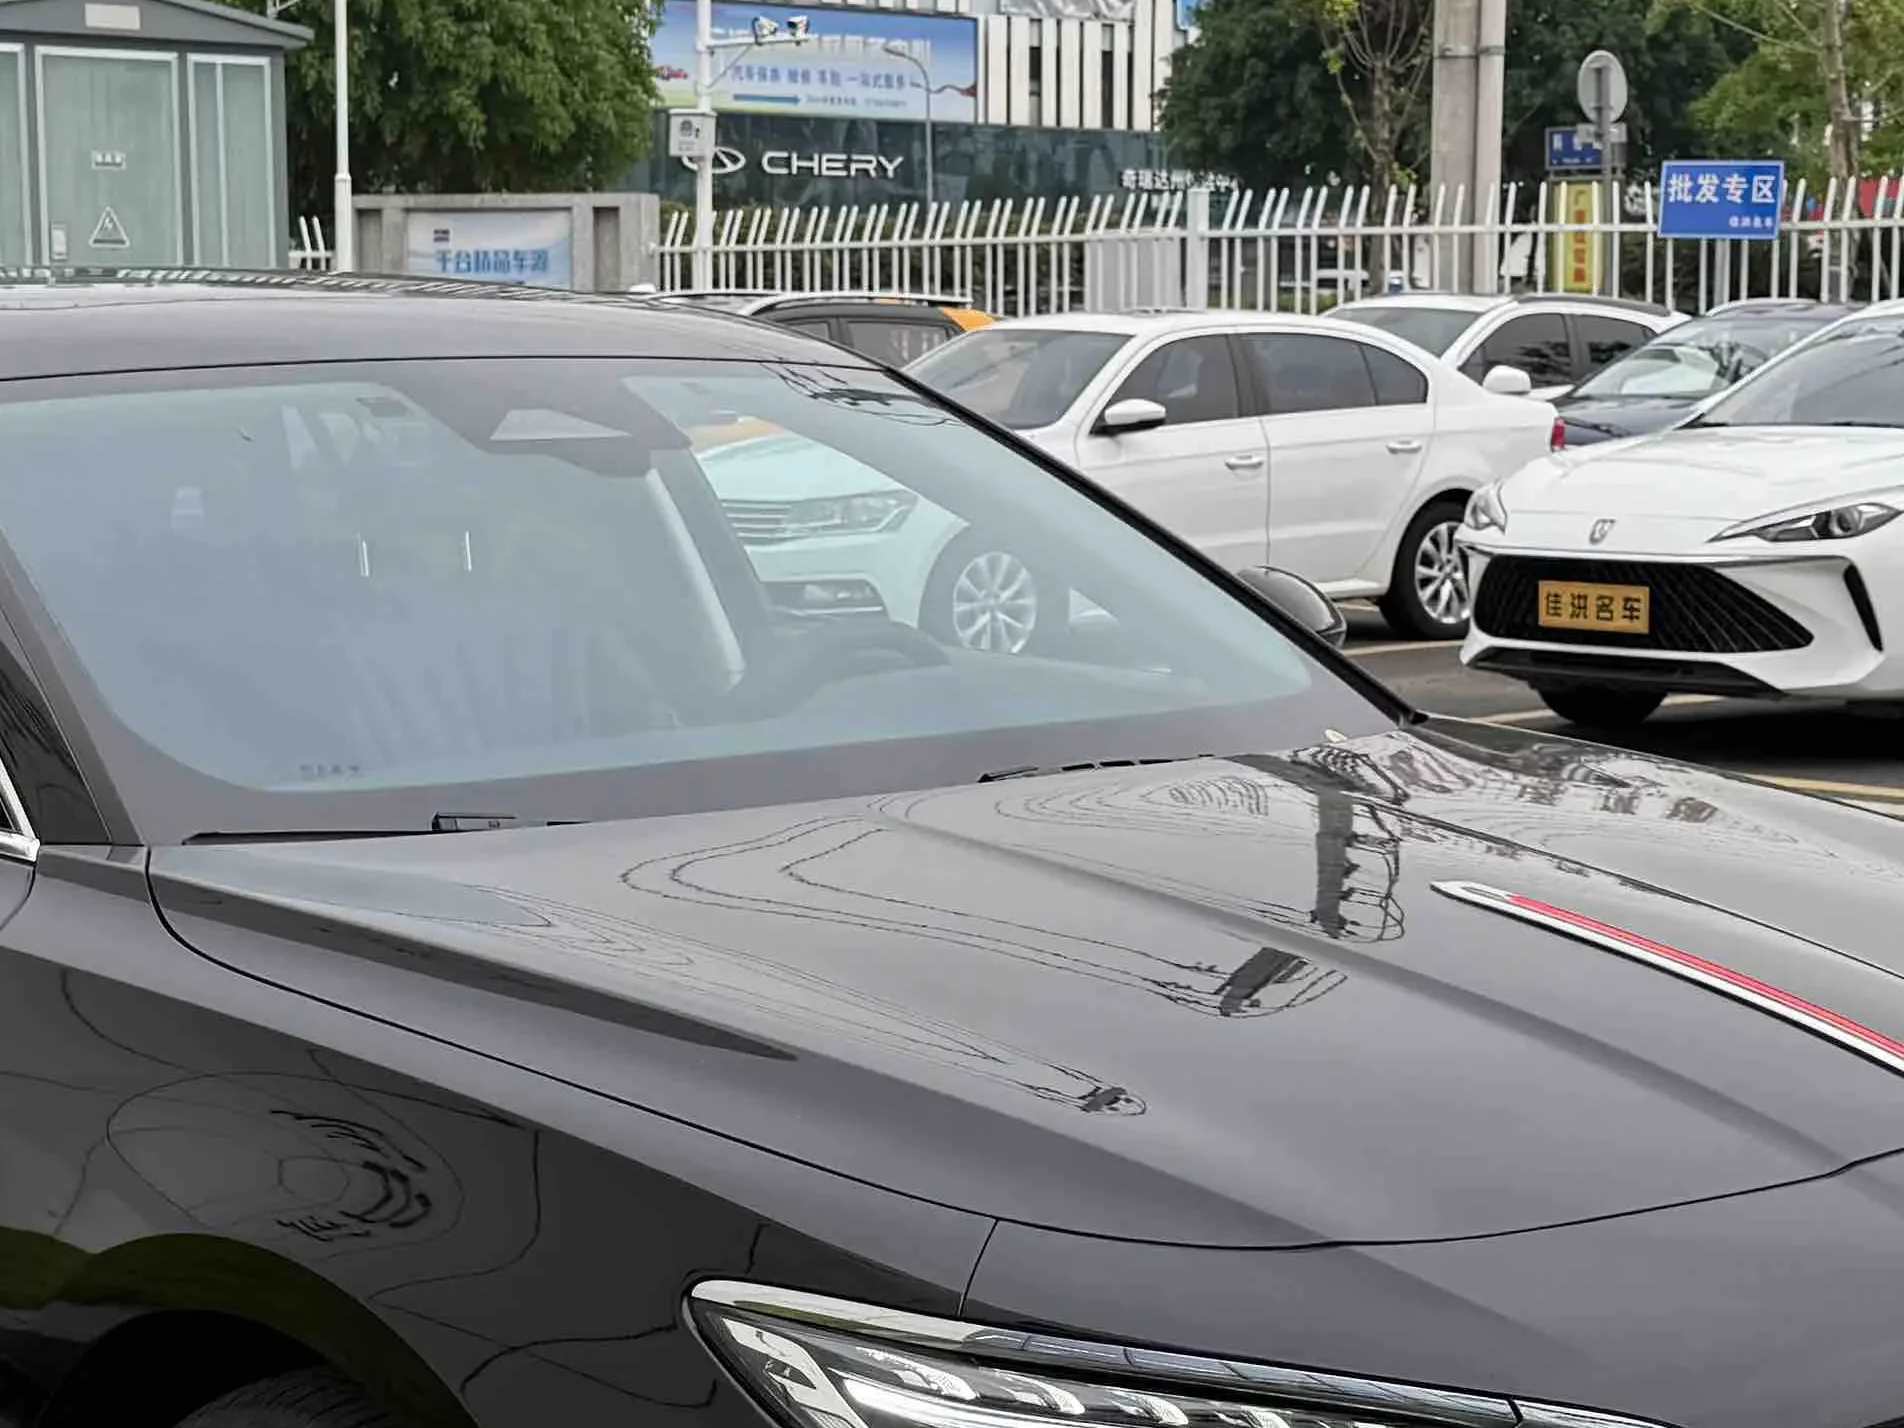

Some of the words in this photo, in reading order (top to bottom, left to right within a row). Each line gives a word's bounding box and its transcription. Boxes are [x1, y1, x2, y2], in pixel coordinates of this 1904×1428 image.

[762, 150, 903, 179] CHERY
[1668, 173, 1776, 205] 批发专区
[1543, 590, 1643, 624] 佳洪名车
